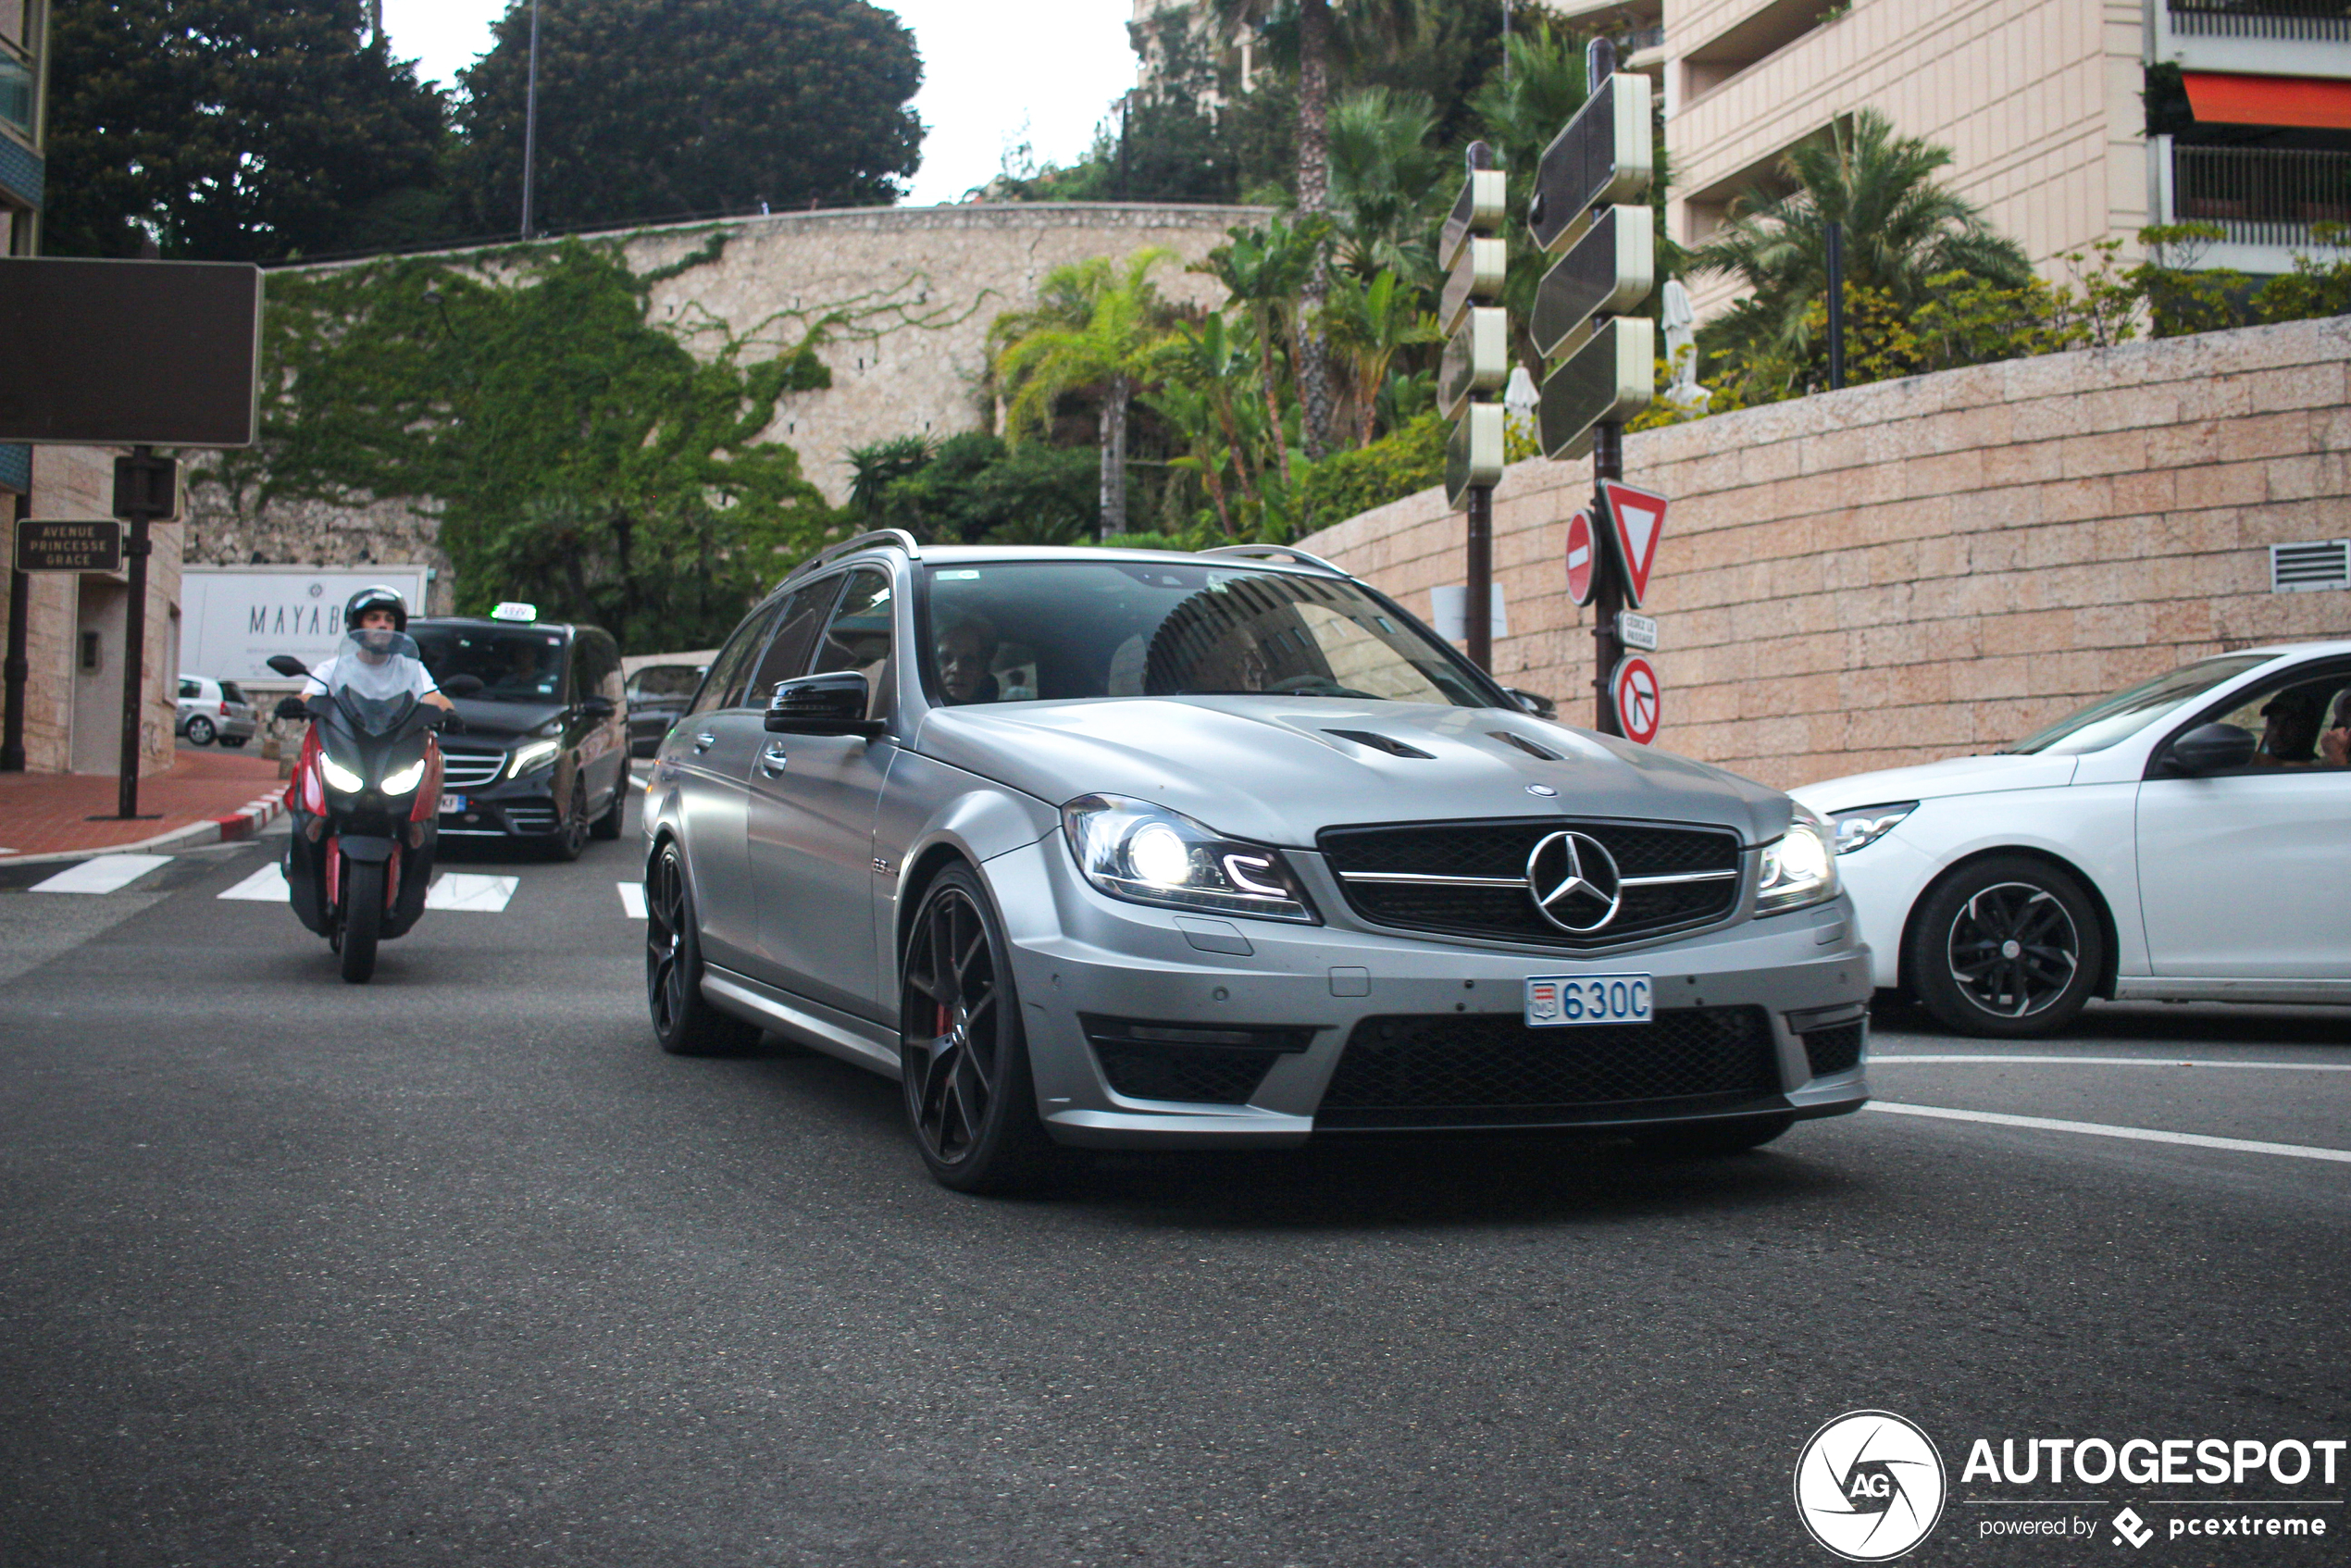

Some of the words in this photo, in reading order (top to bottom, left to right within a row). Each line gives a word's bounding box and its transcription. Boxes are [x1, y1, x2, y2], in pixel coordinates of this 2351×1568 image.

[43, 526, 94, 538] AVENUE
[31, 540, 107, 553] PRINCESSE
[46, 554, 91, 566] GRACE
[249, 604, 341, 635] MAYAB
[1563, 980, 1648, 1020] 630C
